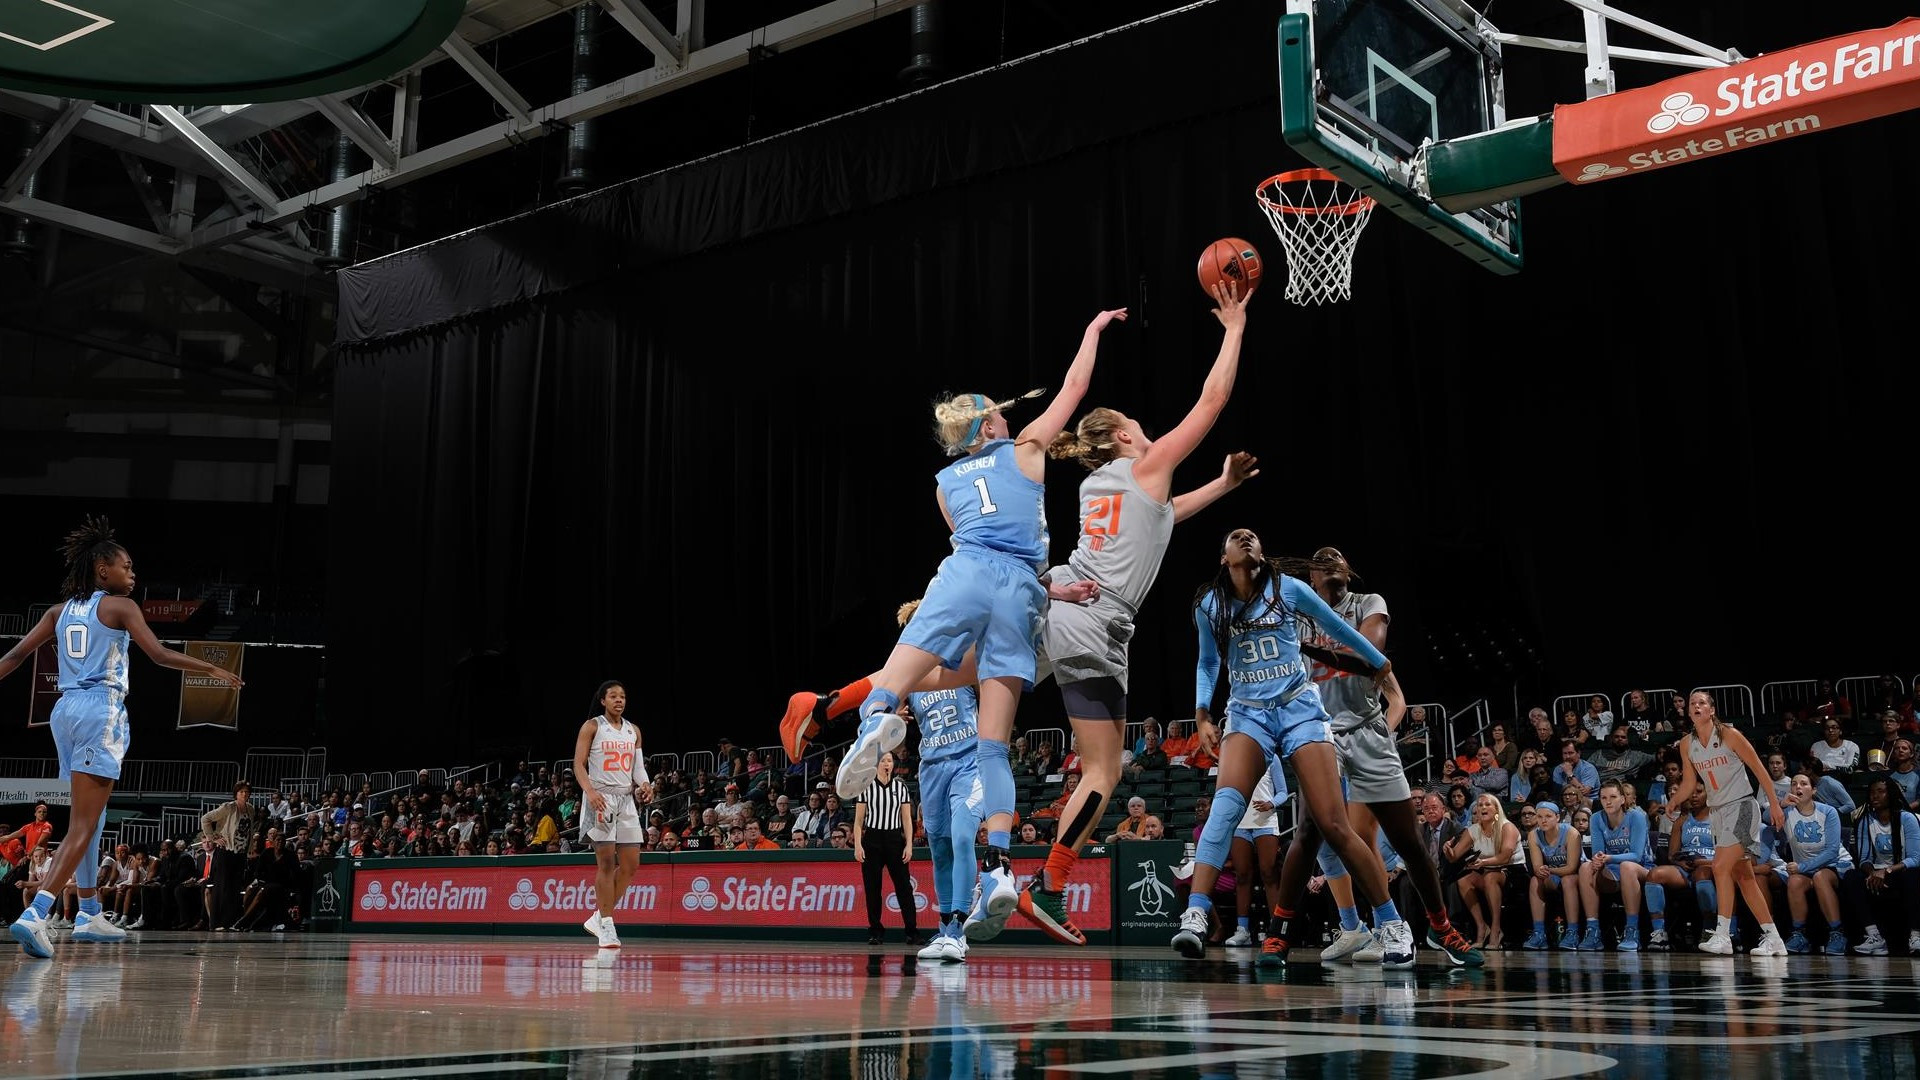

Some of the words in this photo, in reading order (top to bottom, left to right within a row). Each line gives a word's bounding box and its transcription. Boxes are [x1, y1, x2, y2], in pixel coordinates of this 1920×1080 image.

[954, 455, 996, 477] KOENEN
[972, 476, 998, 515] 1
[1084, 493, 1124, 536] 21
[65, 623, 89, 659] 0
[1238, 636, 1280, 664] 30
[185, 678, 208, 686] WAKE
[209, 679, 231, 687] FORE
[1232, 660, 1298, 683] CAROLINA
[920, 689, 957, 709] NORTH
[927, 705, 959, 732] 22
[923, 725, 976, 747] CAROLINA
[603, 752, 634, 772] 20
[1707, 770, 1719, 791] 1
[0, 791, 28, 801] Health
[687, 838, 700, 848] POSS
[1690, 836, 1701, 847] 4
